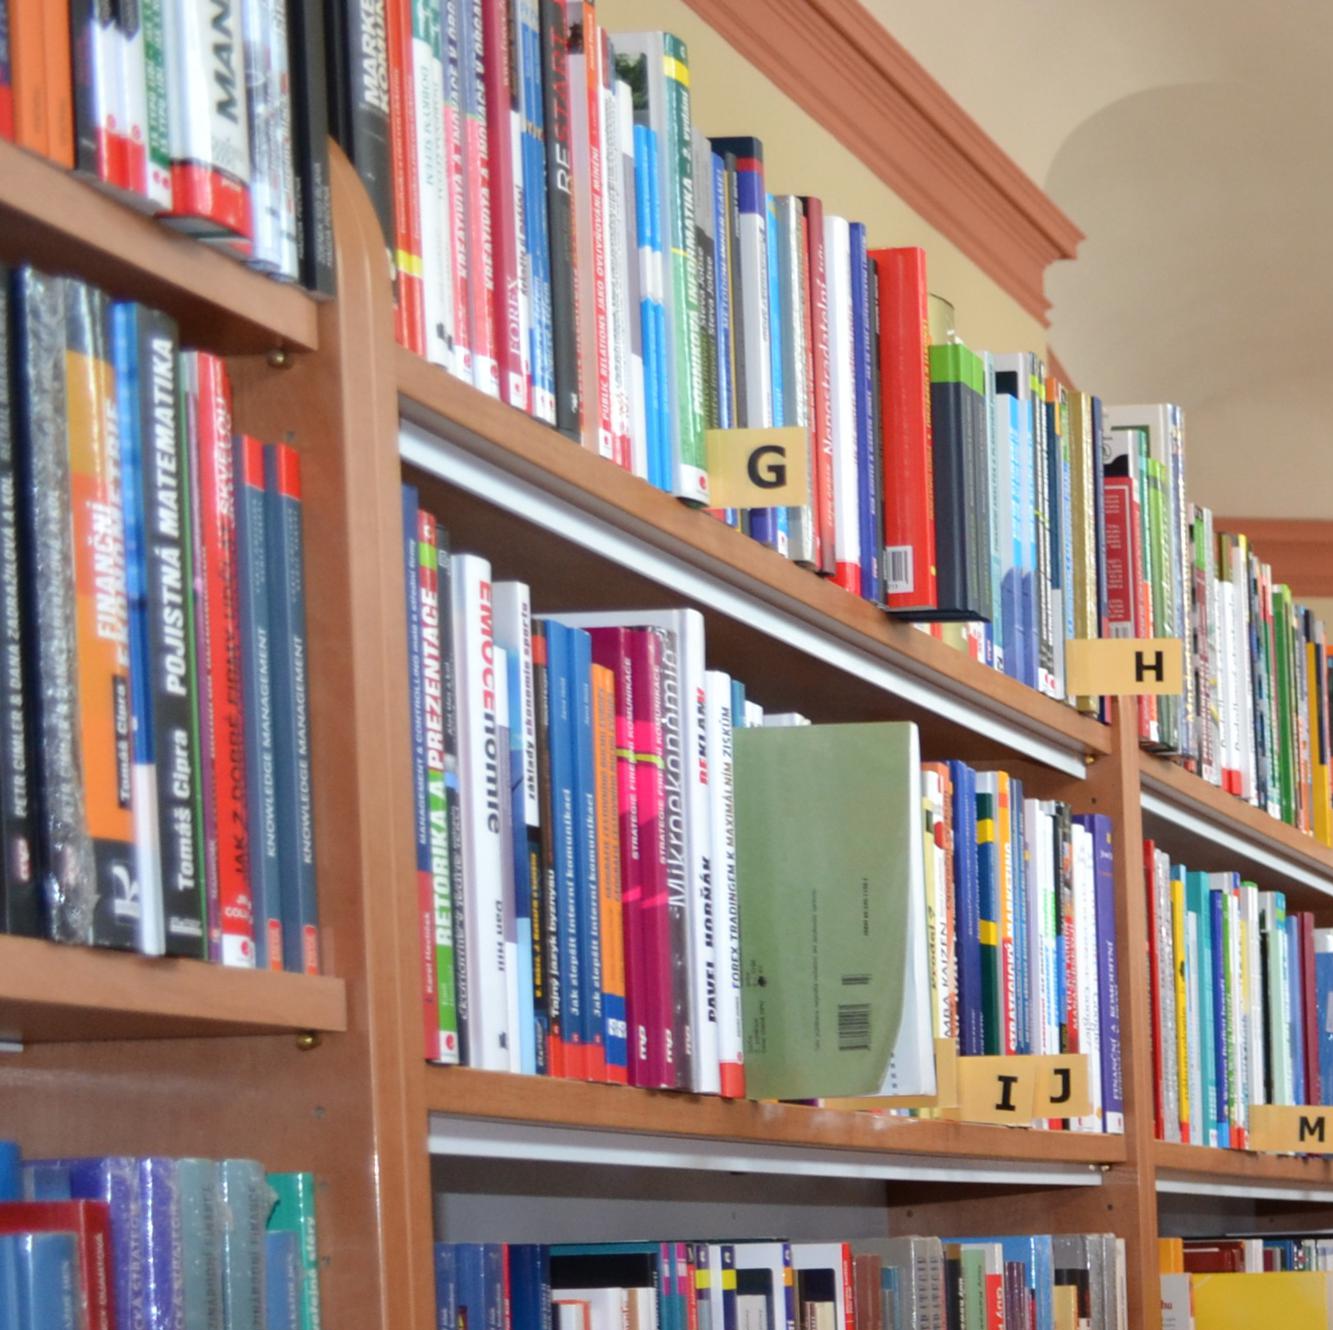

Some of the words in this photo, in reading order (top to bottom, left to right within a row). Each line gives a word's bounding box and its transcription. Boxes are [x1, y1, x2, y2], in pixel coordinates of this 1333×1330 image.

[150, 338, 179, 536] MATEMATIKA
[747, 445, 787, 489] G
[152, 546, 187, 695] POJISTNÁ
[421, 588, 444, 769] PREZENTACE
[1135, 651, 1164, 682] H
[169, 729, 192, 799] Cipra
[428, 779, 445, 800] A
[171, 807, 194, 890] Tomáš
[430, 809, 452, 946] RETORIKA
[1050, 1068, 1072, 1103] J
[1300, 1117, 1325, 1143] M
